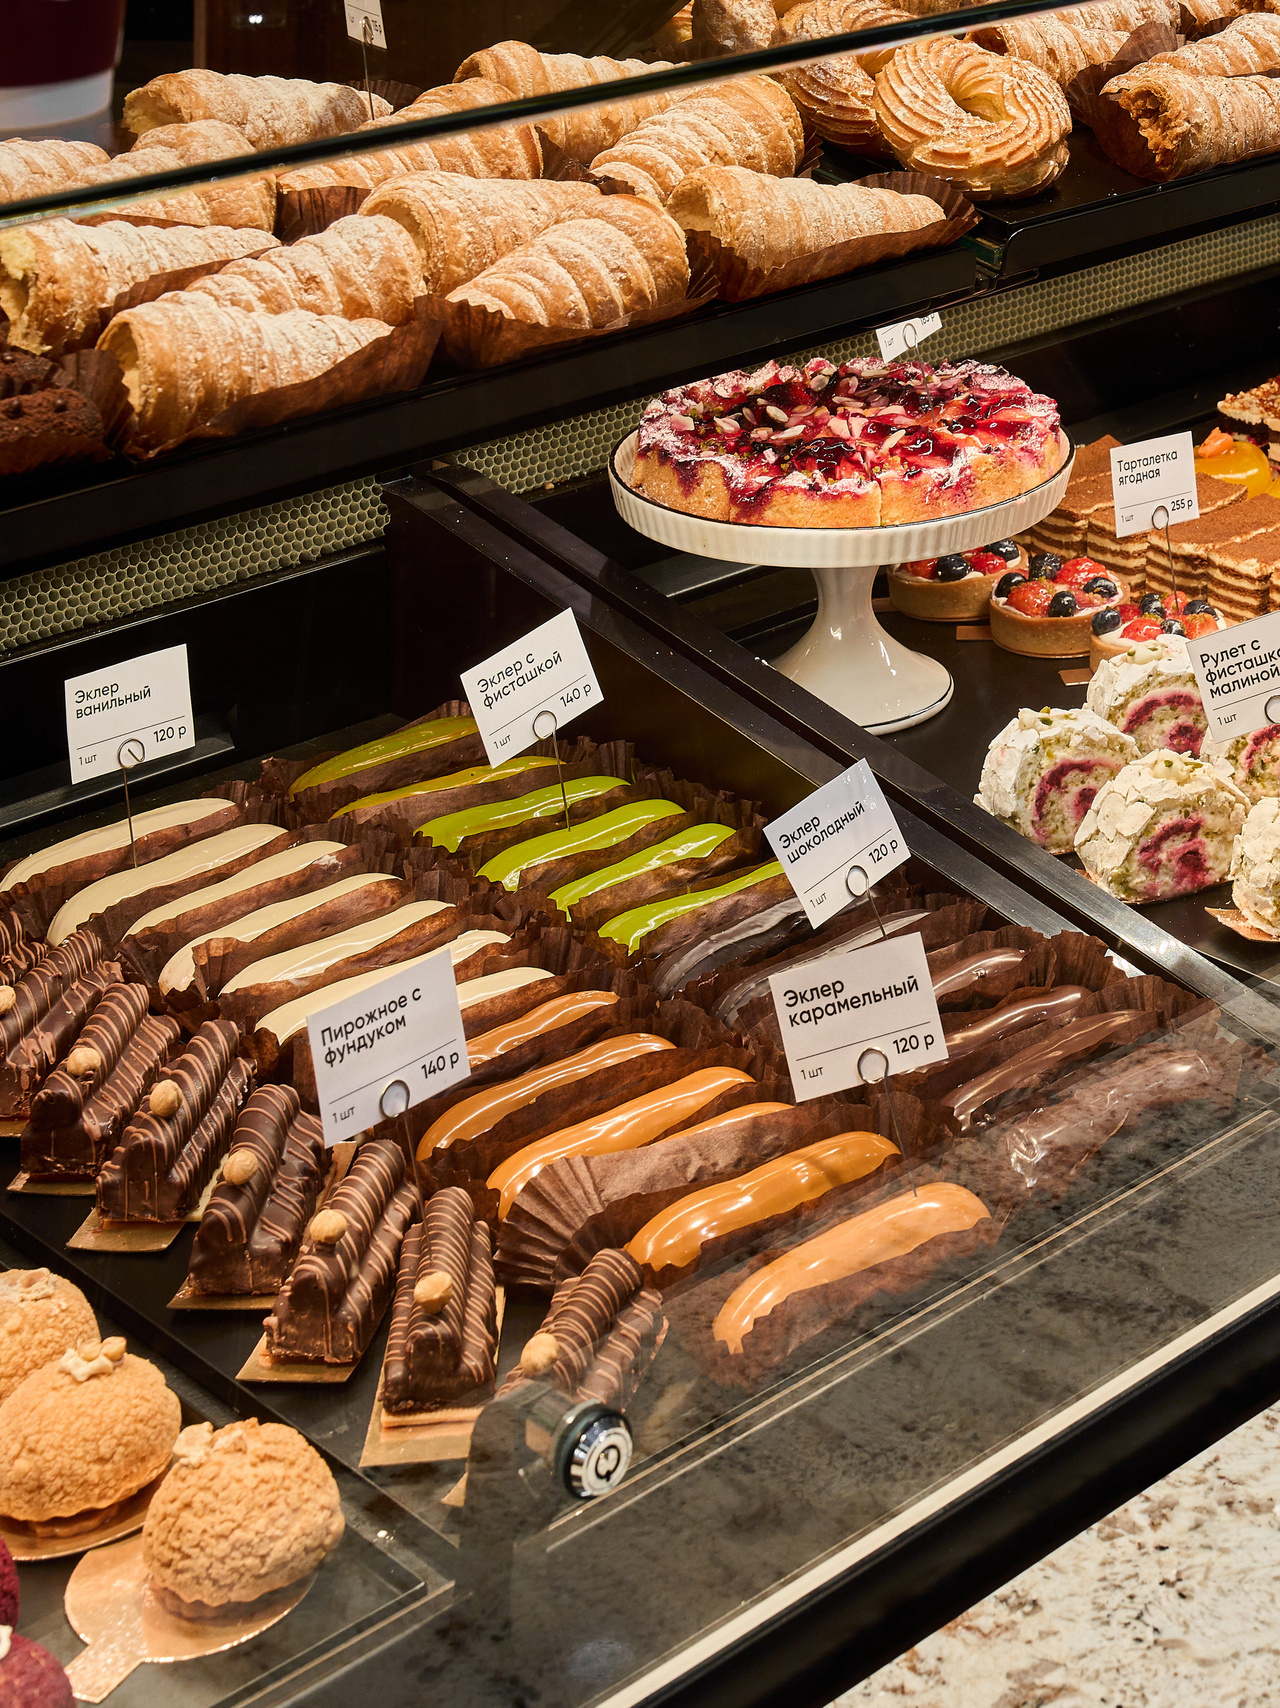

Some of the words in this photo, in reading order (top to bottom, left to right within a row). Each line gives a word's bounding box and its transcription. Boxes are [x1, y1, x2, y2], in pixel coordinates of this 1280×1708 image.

[1117, 451, 1178, 472] Тарталетка
[1119, 468, 1160, 486] ягодная
[1171, 499, 1185, 511] 255
[1187, 499, 1193, 510] р
[1200, 644, 1246, 668] Рулет
[1251, 640, 1261, 650] с
[477, 661, 522, 693] Эклер
[526, 653, 535, 664] с
[483, 651, 562, 710] фисташкой
[1210, 664, 1280, 698] малиной
[75, 683, 119, 703] Эклер
[76, 686, 151, 719] ванильный
[560, 688, 581, 707] 140
[583, 683, 592, 697] р
[1217, 717, 1222, 725] 1
[1224, 713, 1237, 724] шт
[154, 727, 174, 742] 120
[179, 726, 186, 738] р
[499, 735, 511, 747] шт
[85, 754, 97, 764] шт
[779, 816, 820, 849] Эклер
[787, 801, 865, 864] шоколадный
[869, 843, 888, 864] 120
[889, 839, 898, 853] р
[815, 893, 826, 905] шт
[783, 980, 845, 1007] Эклер
[789, 975, 919, 1027] карамельный
[321, 994, 407, 1046] Пирожное
[412, 988, 422, 1000] с
[324, 1015, 406, 1068] фундуком
[893, 1034, 919, 1054] 120
[924, 1034, 934, 1050] р
[421, 1055, 446, 1079] 140
[450, 1052, 459, 1069] р
[801, 1070, 806, 1080] 1
[809, 1066, 823, 1079] шт
[333, 1113, 337, 1123] 1
[340, 1106, 355, 1120] шт
